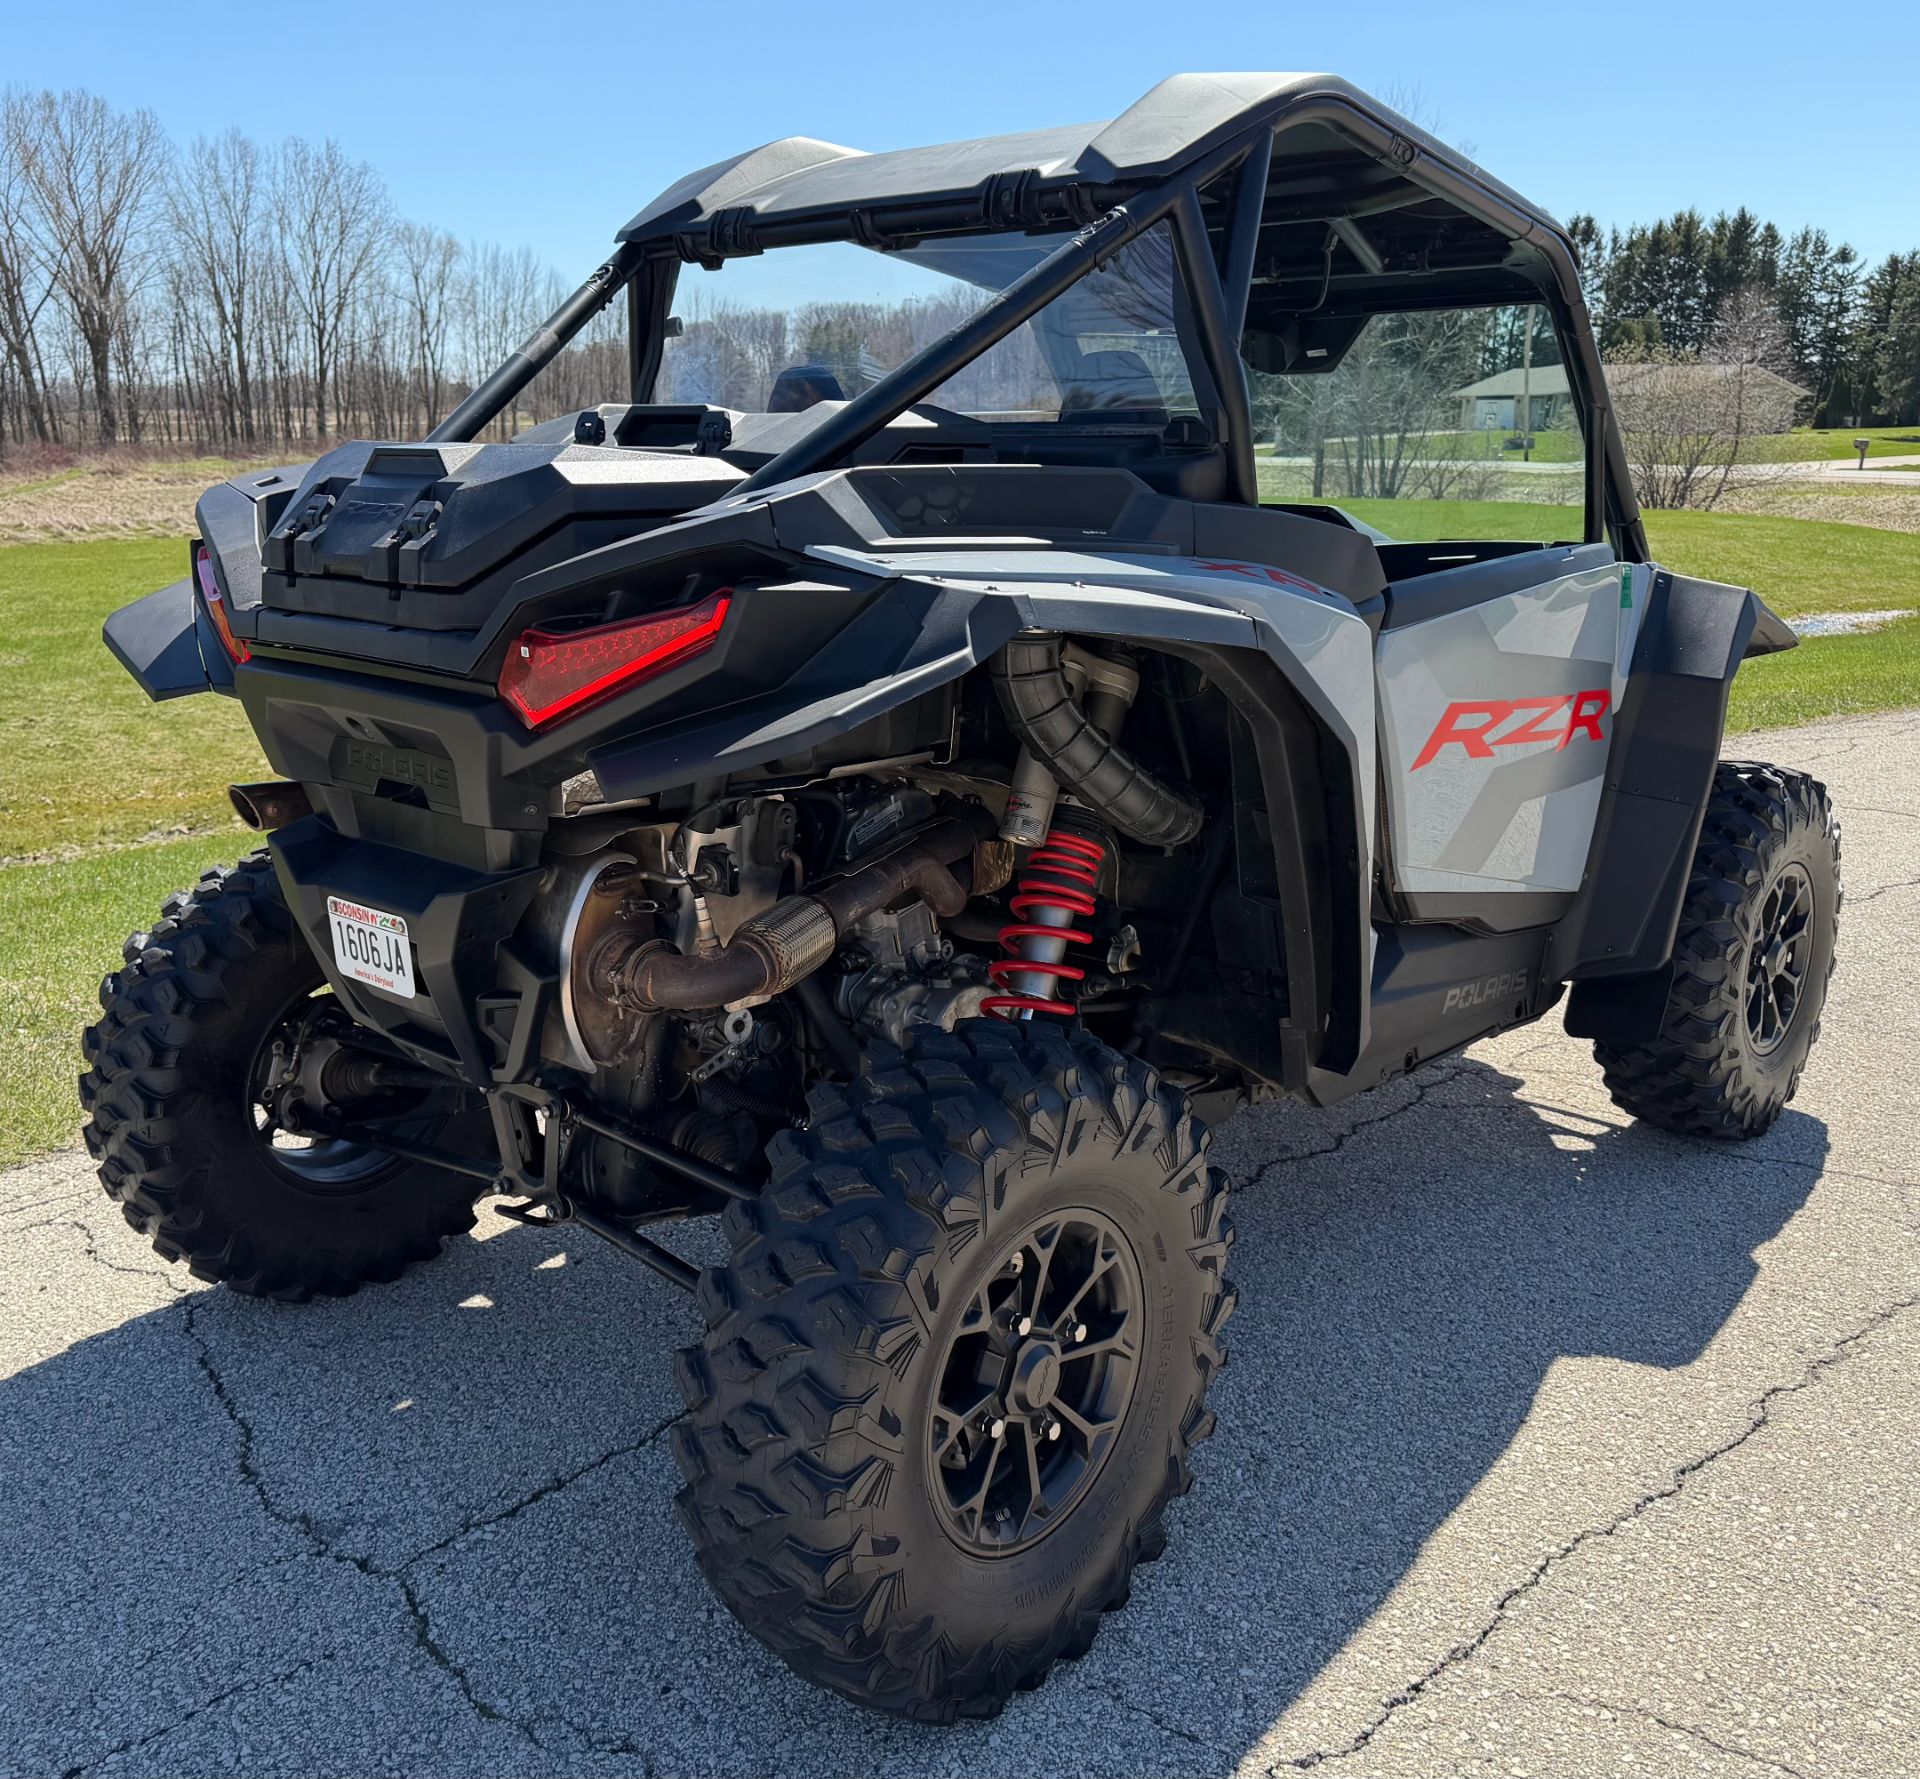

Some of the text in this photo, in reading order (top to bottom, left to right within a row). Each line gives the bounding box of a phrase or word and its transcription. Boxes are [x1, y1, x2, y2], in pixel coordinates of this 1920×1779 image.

[1409, 688, 1612, 773] RZR
[346, 744, 449, 790] POLARIS
[331, 900, 370, 924] SCONSIN
[337, 920, 406, 978] 1606JA
[1442, 967, 1528, 1015] POLARIS
